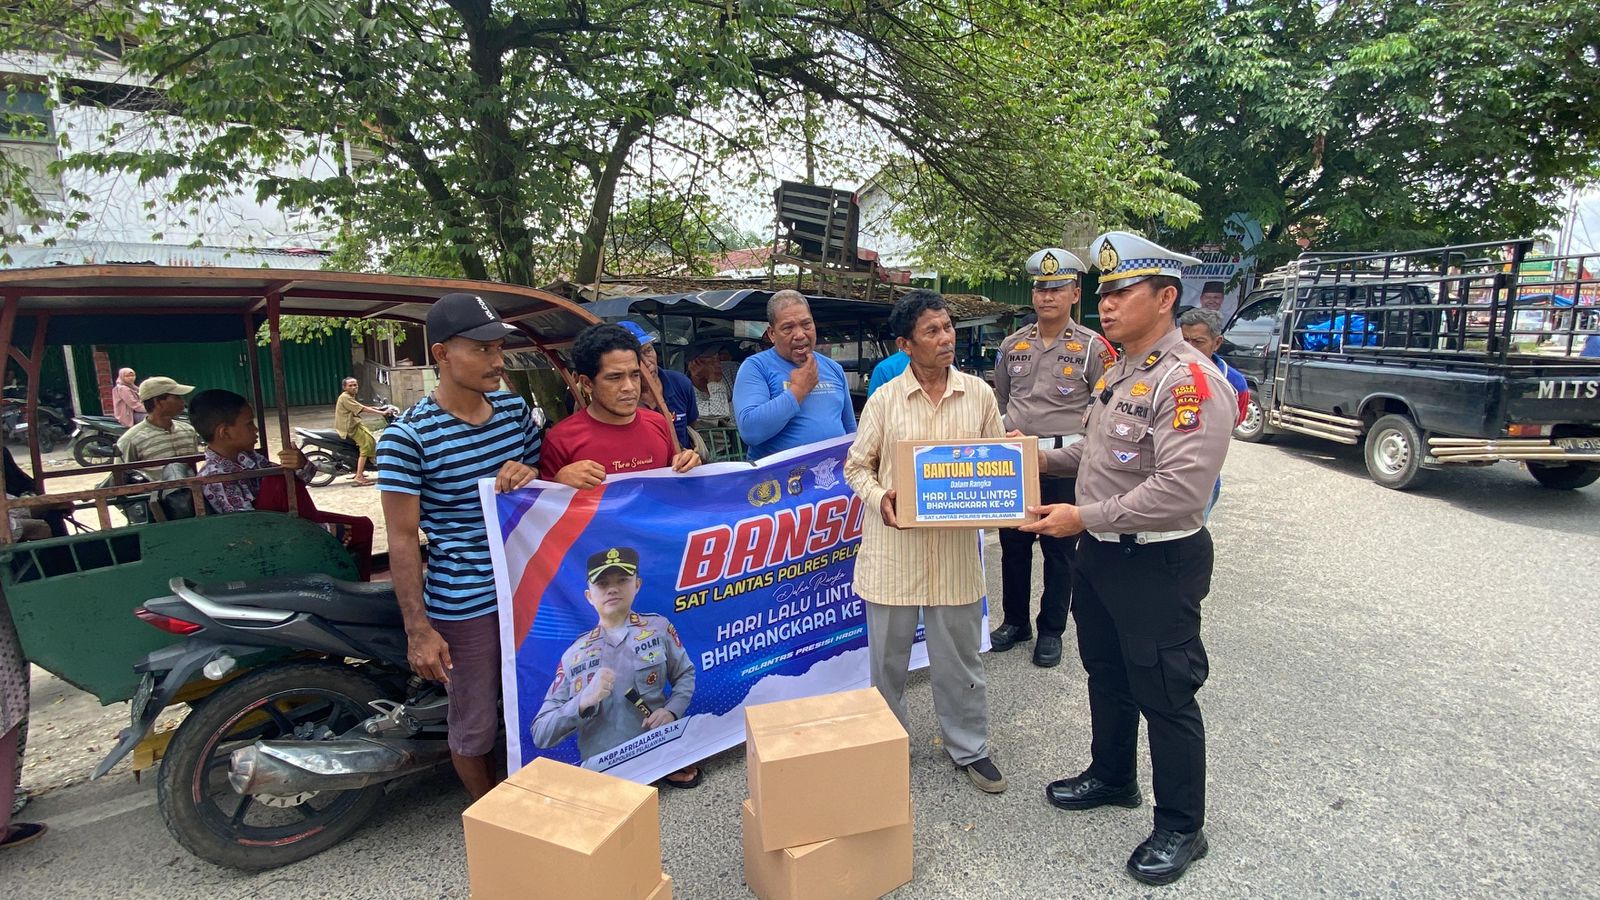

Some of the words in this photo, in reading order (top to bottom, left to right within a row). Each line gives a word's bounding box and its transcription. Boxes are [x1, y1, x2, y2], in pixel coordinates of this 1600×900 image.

[475, 296, 495, 320] VOLCOM
[1009, 354, 1032, 362] HADI
[1057, 355, 1085, 365] POLRI
[1537, 380, 1599, 399] MITS
[1114, 401, 1149, 418] POLRI
[923, 462, 974, 479] BANTUAN
[976, 461, 1016, 477] SOSIAL
[969, 480, 992, 488] Rangka
[923, 491, 947, 501] HARI
[950, 491, 977, 501] LALU
[980, 489, 1017, 499] LINTAS
[926, 500, 987, 509] BHAYANGKARA
[989, 500, 1015, 508] KE-69
[674, 588, 709, 613] SAT
[713, 572, 774, 601] LANTAS
[777, 553, 829, 582] POLRES
[772, 581, 808, 603] Dalam
[809, 568, 847, 590] Rangka
[717, 613, 762, 642] HARI
[767, 596, 811, 624] LALU
[635, 637, 660, 654] POLRI
[700, 609, 837, 671] BHAYANGKARA
[741, 651, 794, 677] POLANTAS
[795, 637, 834, 656] PRESISI
[835, 626, 863, 641] HADIR
[598, 748, 619, 764] AKBP
[620, 731, 664, 755] AFRIZALASRI,
[664, 723, 680, 736] S.I.K
[607, 750, 636, 766] KAPOLRES
[636, 737, 666, 754] PELALAWAN
